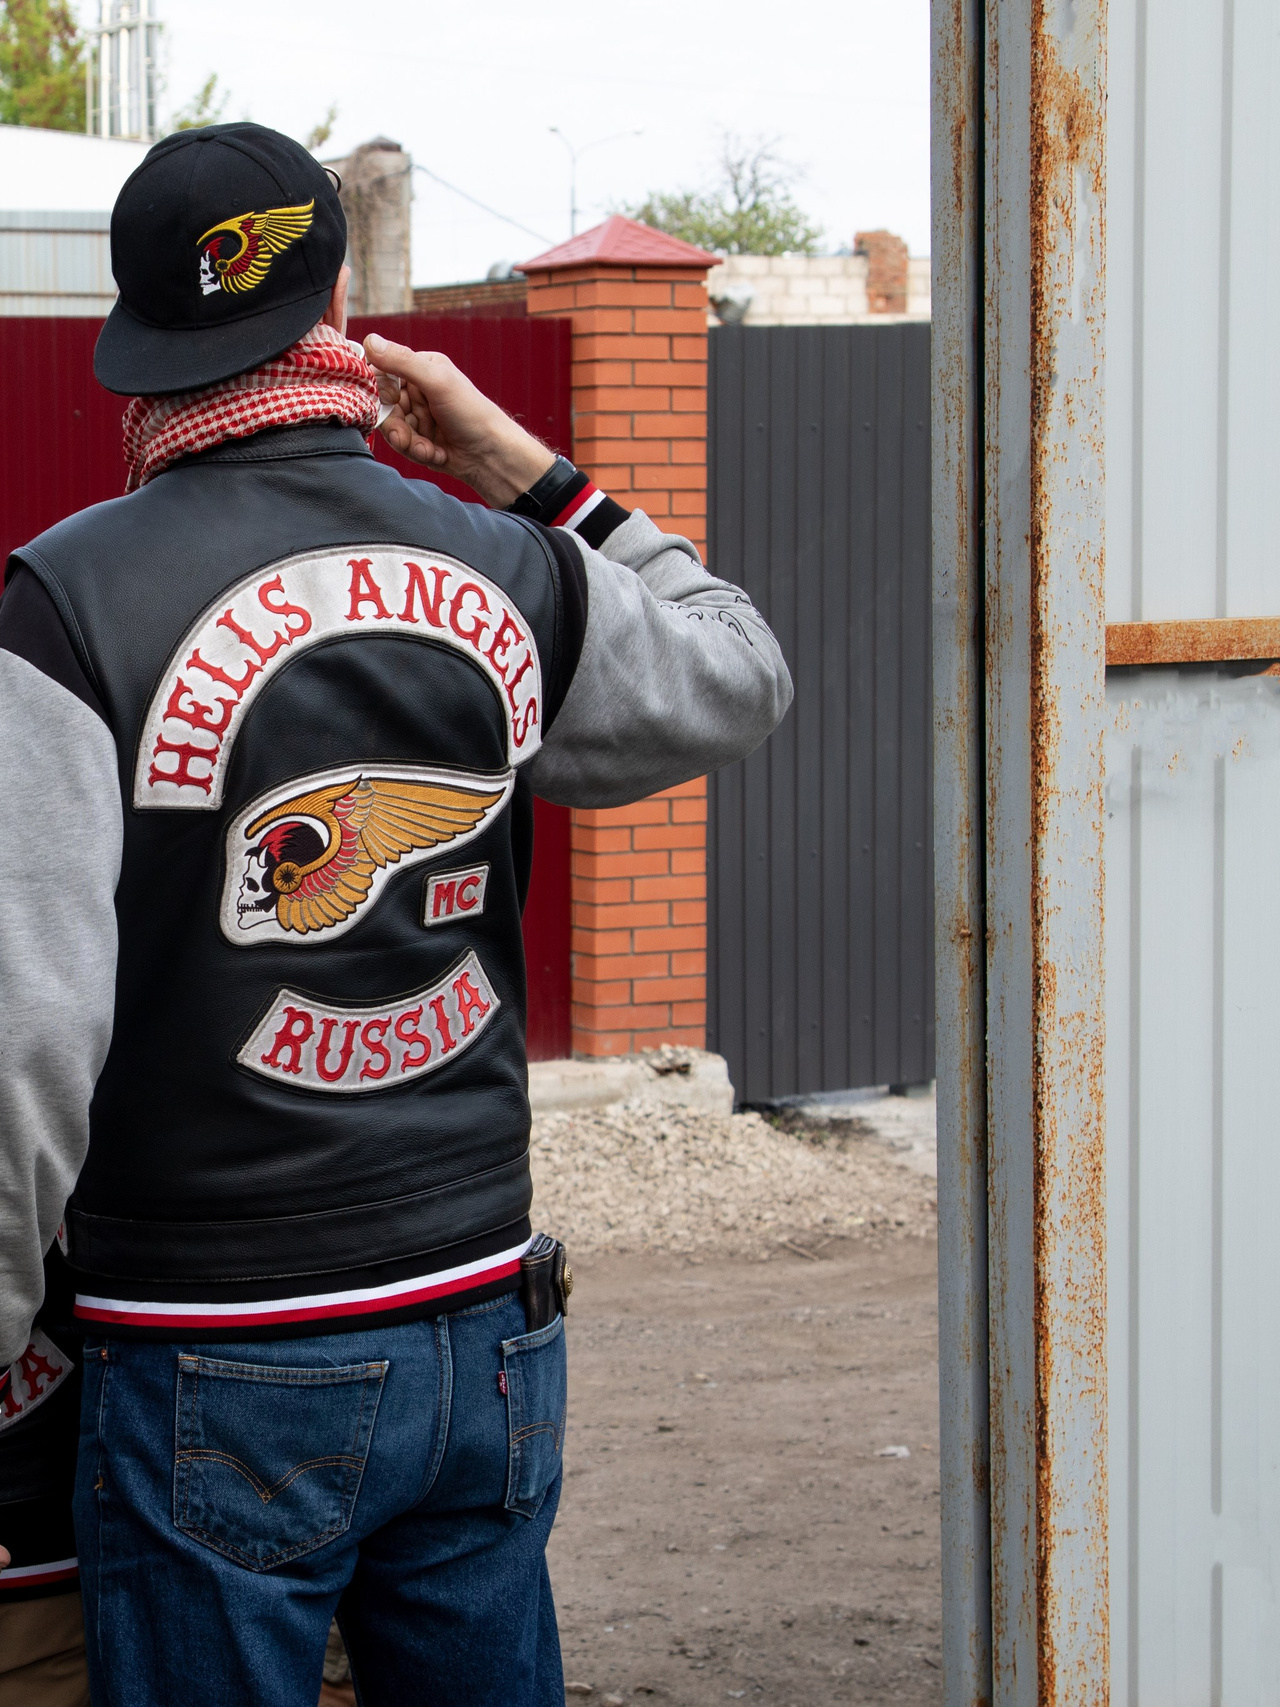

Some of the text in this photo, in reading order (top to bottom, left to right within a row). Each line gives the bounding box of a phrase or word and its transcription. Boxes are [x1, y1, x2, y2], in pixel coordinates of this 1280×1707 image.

[148, 574, 312, 796] HELLS
[345, 557, 537, 748] ANGELS
[432, 874, 481, 918] MC
[262, 971, 491, 1083] RUSSIA
